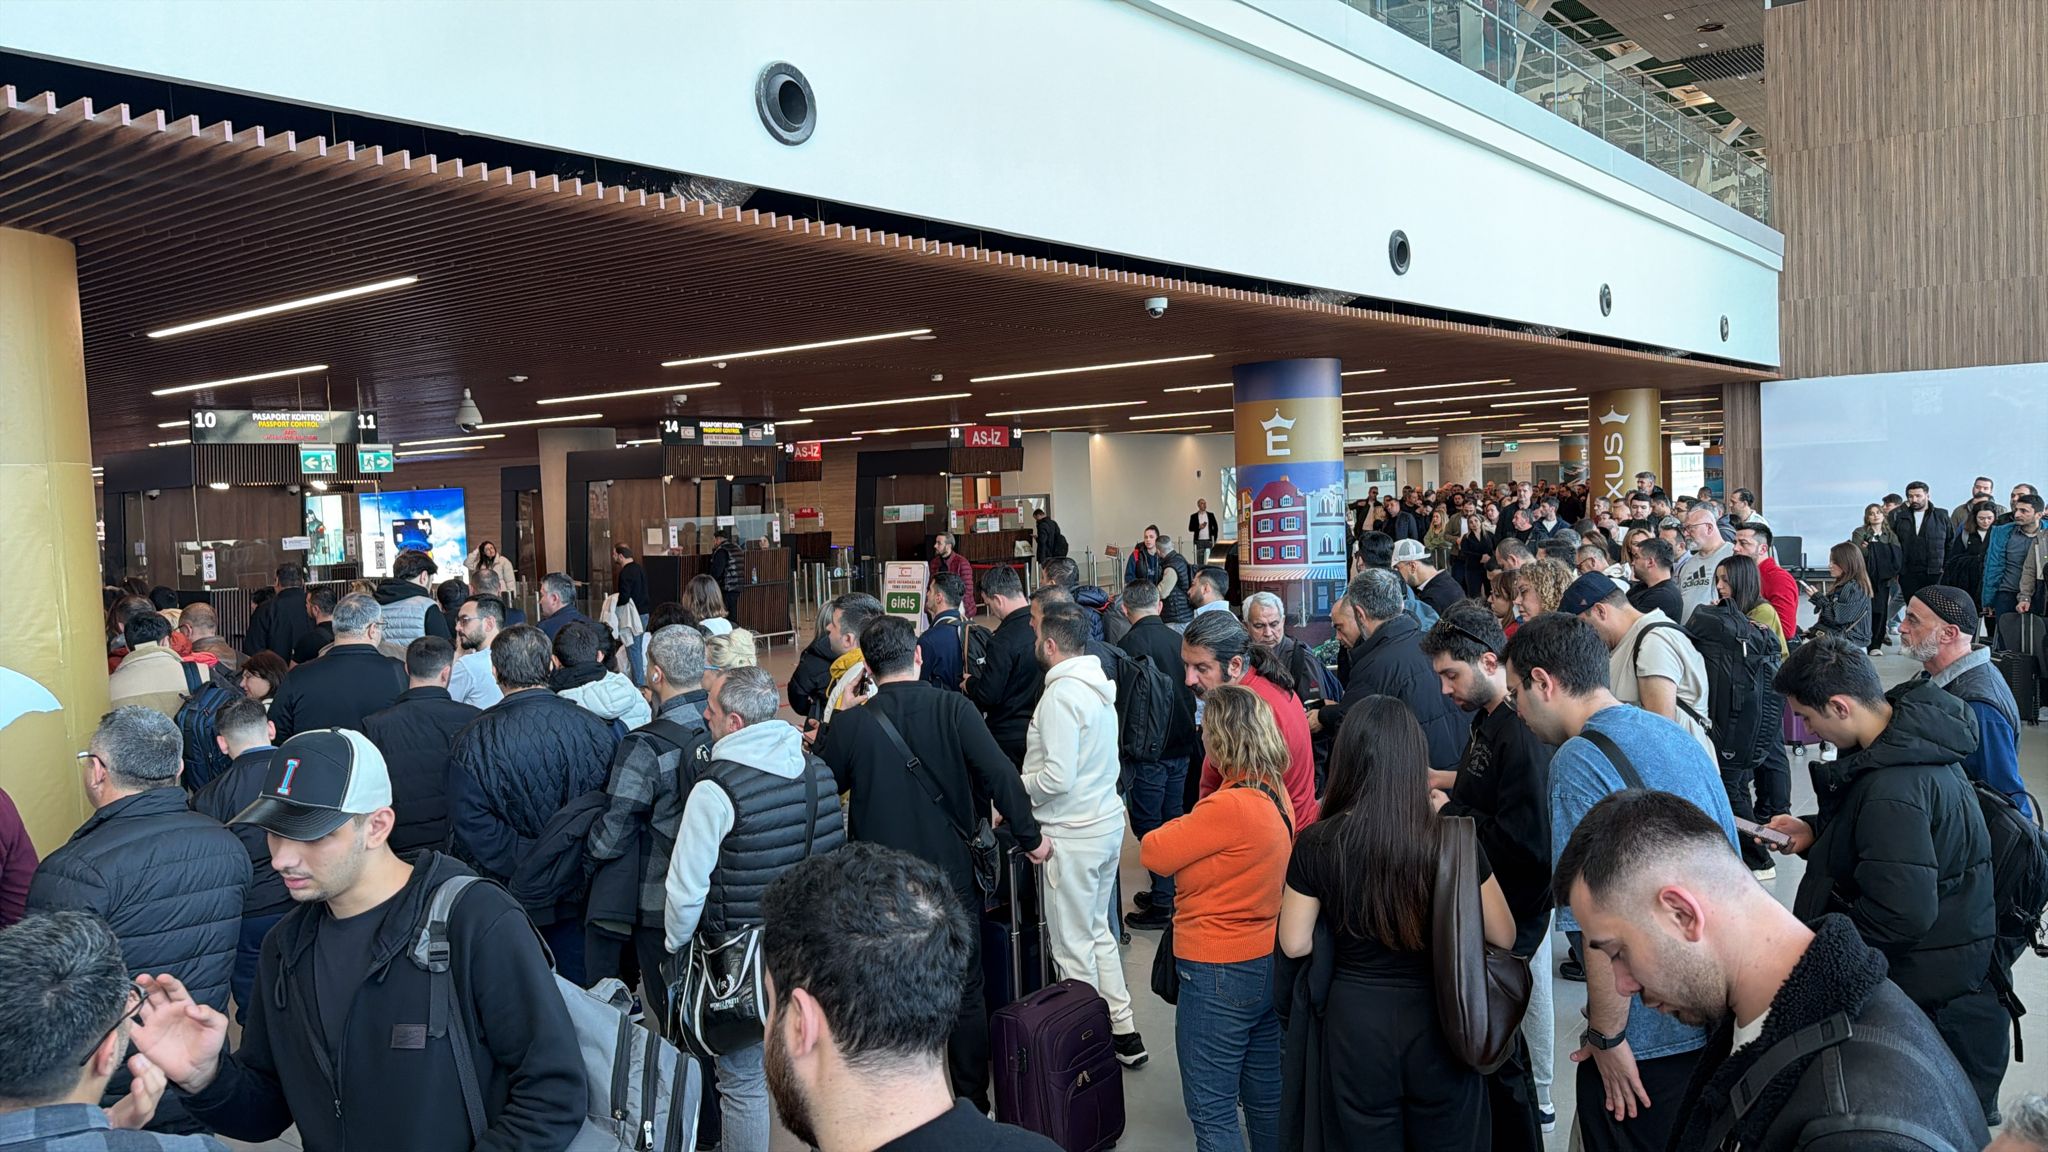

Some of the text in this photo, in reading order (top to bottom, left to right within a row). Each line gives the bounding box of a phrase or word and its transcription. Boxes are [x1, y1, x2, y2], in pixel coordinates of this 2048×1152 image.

[194, 411, 217, 428] 10
[252, 413, 325, 422] PASAPORT KONTROL
[357, 414, 376, 429] 11
[258, 420, 320, 428] PASSPORT CONTROL
[664, 420, 679, 433] 14
[763, 423, 775, 435] 15
[972, 428, 1001, 445] AS-İZ
[785, 444, 794, 453] 20
[1681, 578, 1710, 589] adidas
[890, 595, 916, 611] GİRİŞ
